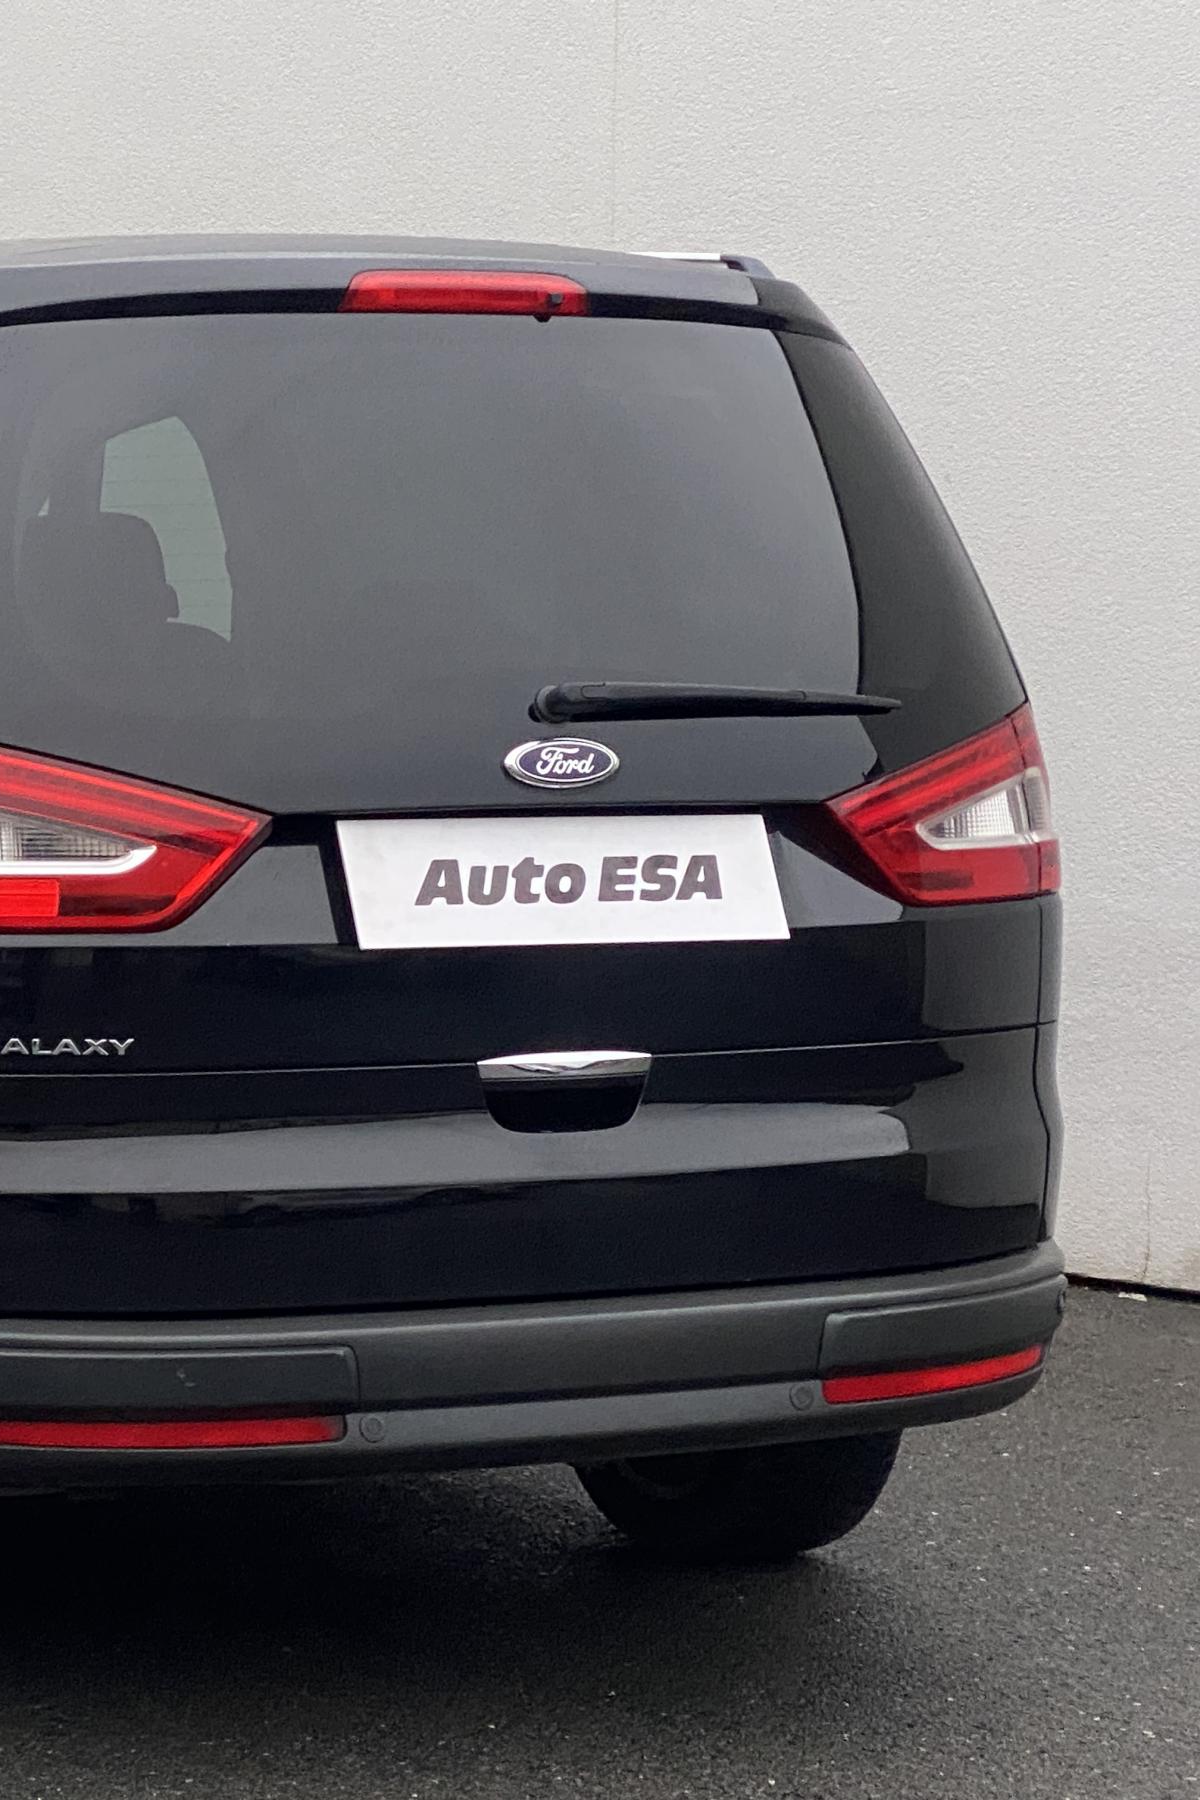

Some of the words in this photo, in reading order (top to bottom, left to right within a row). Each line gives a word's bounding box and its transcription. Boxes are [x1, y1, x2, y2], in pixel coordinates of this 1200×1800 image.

[536, 746, 595, 775] Ford
[415, 857, 586, 905] Auto
[598, 854, 723, 901] ESA
